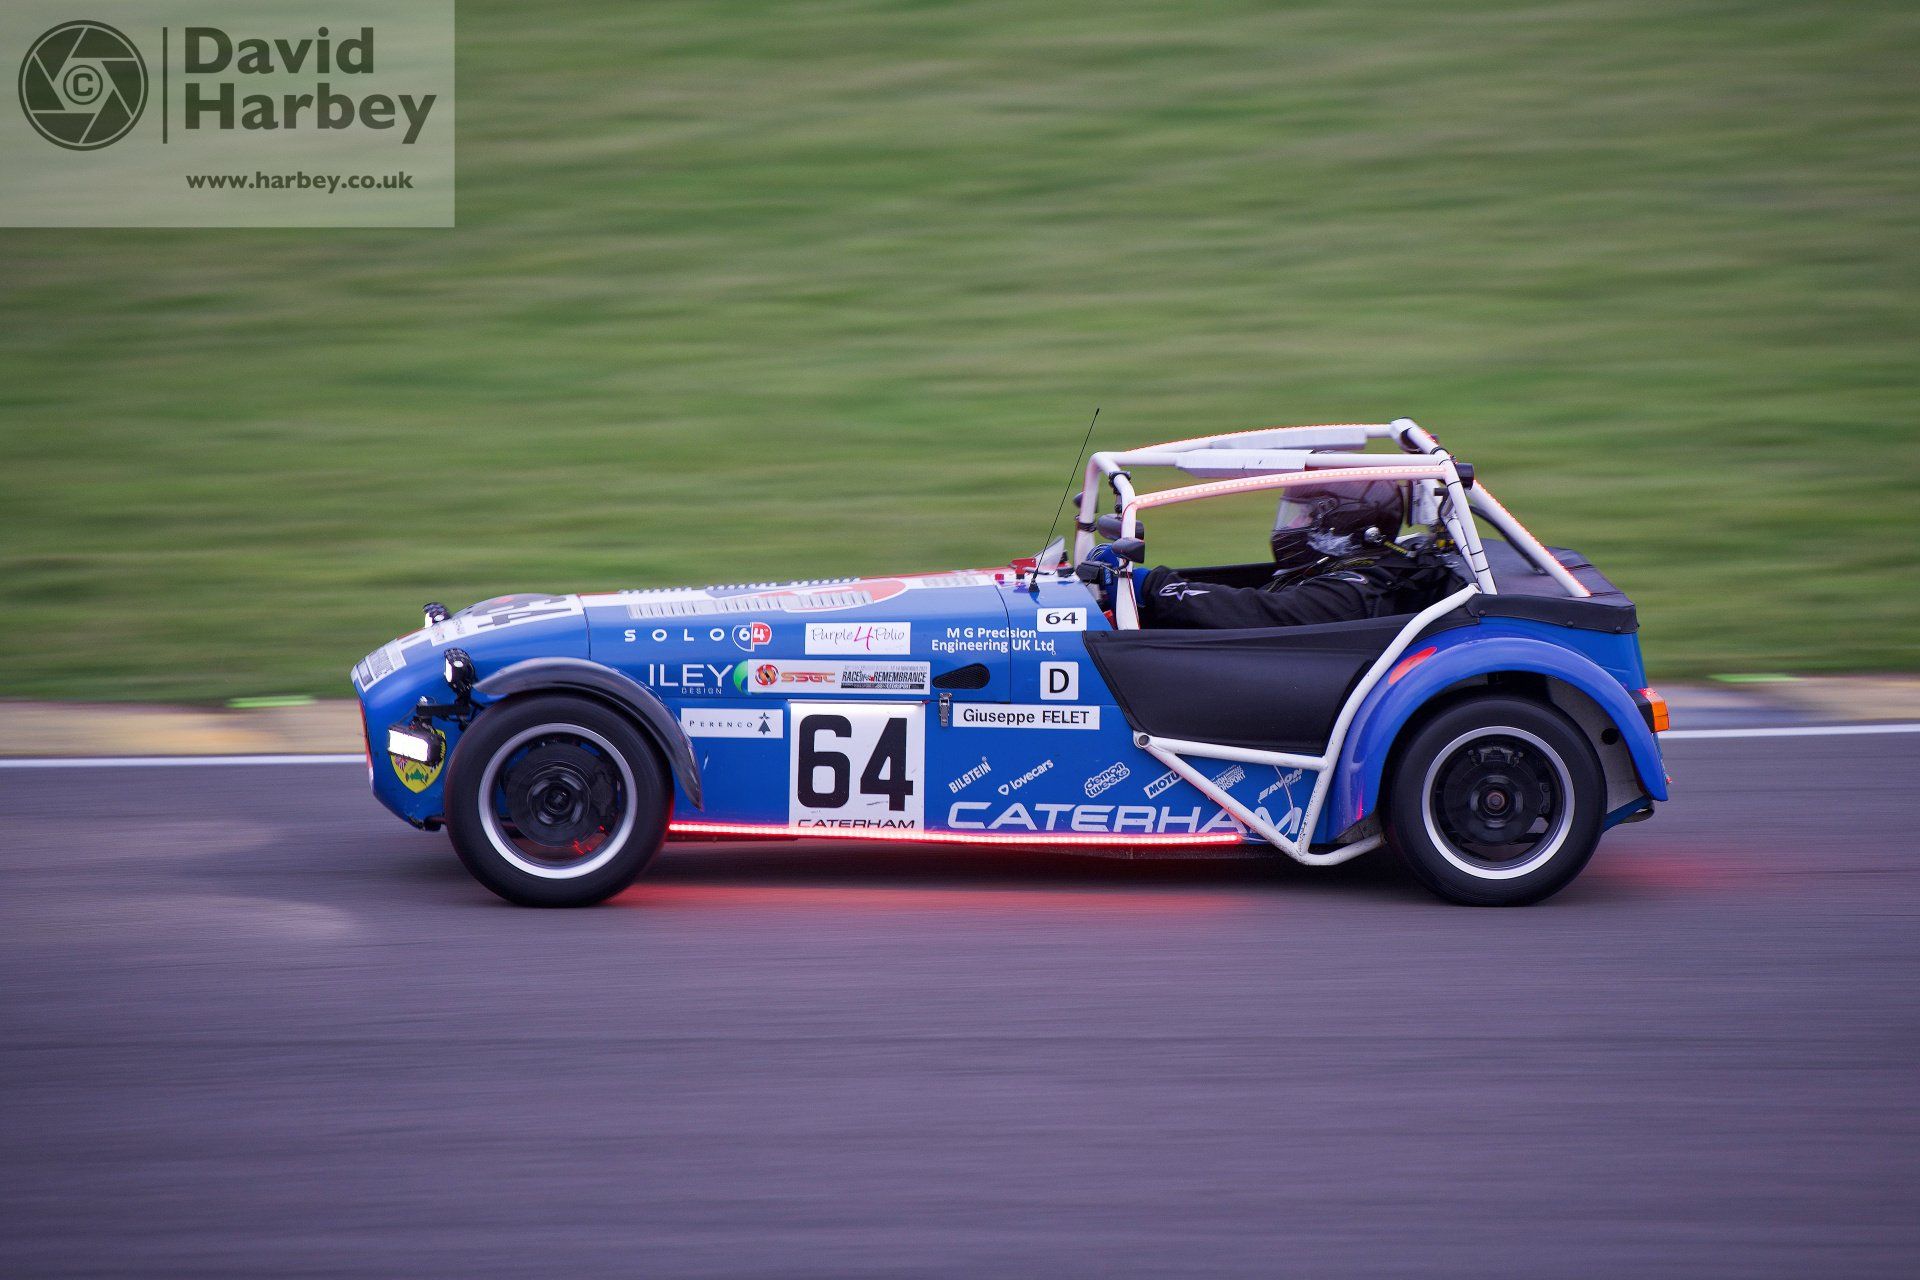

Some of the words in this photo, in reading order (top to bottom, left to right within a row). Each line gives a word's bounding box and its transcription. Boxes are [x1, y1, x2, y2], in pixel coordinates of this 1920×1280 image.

[1045, 611, 1079, 625] 64
[623, 628, 725, 642] SOLO
[738, 627, 765, 641] 64
[811, 626, 853, 646] Purple
[853, 625, 874, 651] 4
[874, 626, 905, 641] Polio
[946, 627, 960, 639] M
[964, 627, 974, 639] G
[977, 627, 1037, 639] Precision
[931, 639, 1009, 654] Engineering
[1012, 639, 1031, 651] UK
[1034, 639, 1055, 652] Ltd
[649, 663, 734, 687] ILEY
[841, 671, 860, 683] RACE
[873, 671, 927, 683] REMEMBRANCE
[1049, 668, 1070, 694] D
[681, 687, 722, 695] DESIGN
[963, 708, 1036, 727] Giuseppe
[1042, 710, 1090, 725] FELET
[797, 714, 914, 812] 64
[948, 759, 992, 794] BILSTEIN
[1010, 759, 1054, 790] lovecars
[1085, 761, 1125, 790] demon
[1147, 770, 1182, 796] MOTU
[797, 819, 916, 829] CATERHAM
